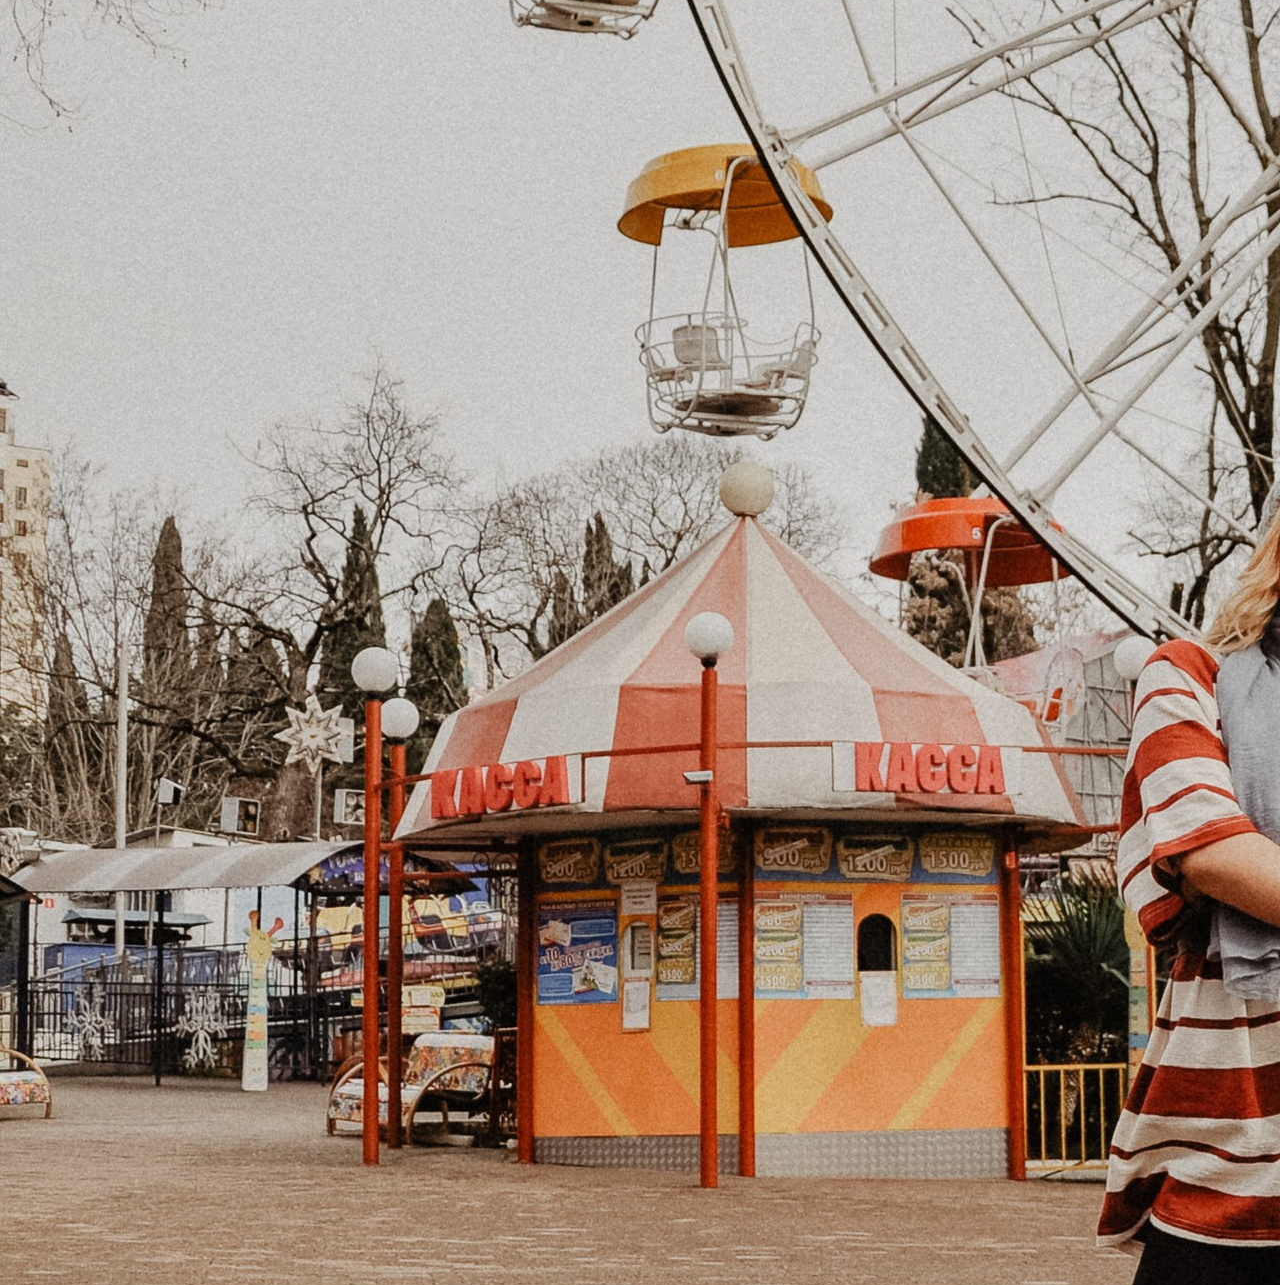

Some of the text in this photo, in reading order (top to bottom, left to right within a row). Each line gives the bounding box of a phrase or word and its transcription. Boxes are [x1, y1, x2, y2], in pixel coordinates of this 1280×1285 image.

[971, 527, 981, 540] 5
[855, 741, 1006, 794] КАССА
[430, 755, 570, 820] КАССА
[846, 855, 887, 873] 1200
[928, 850, 970, 869] 1500
[547, 948, 560, 961] 10
